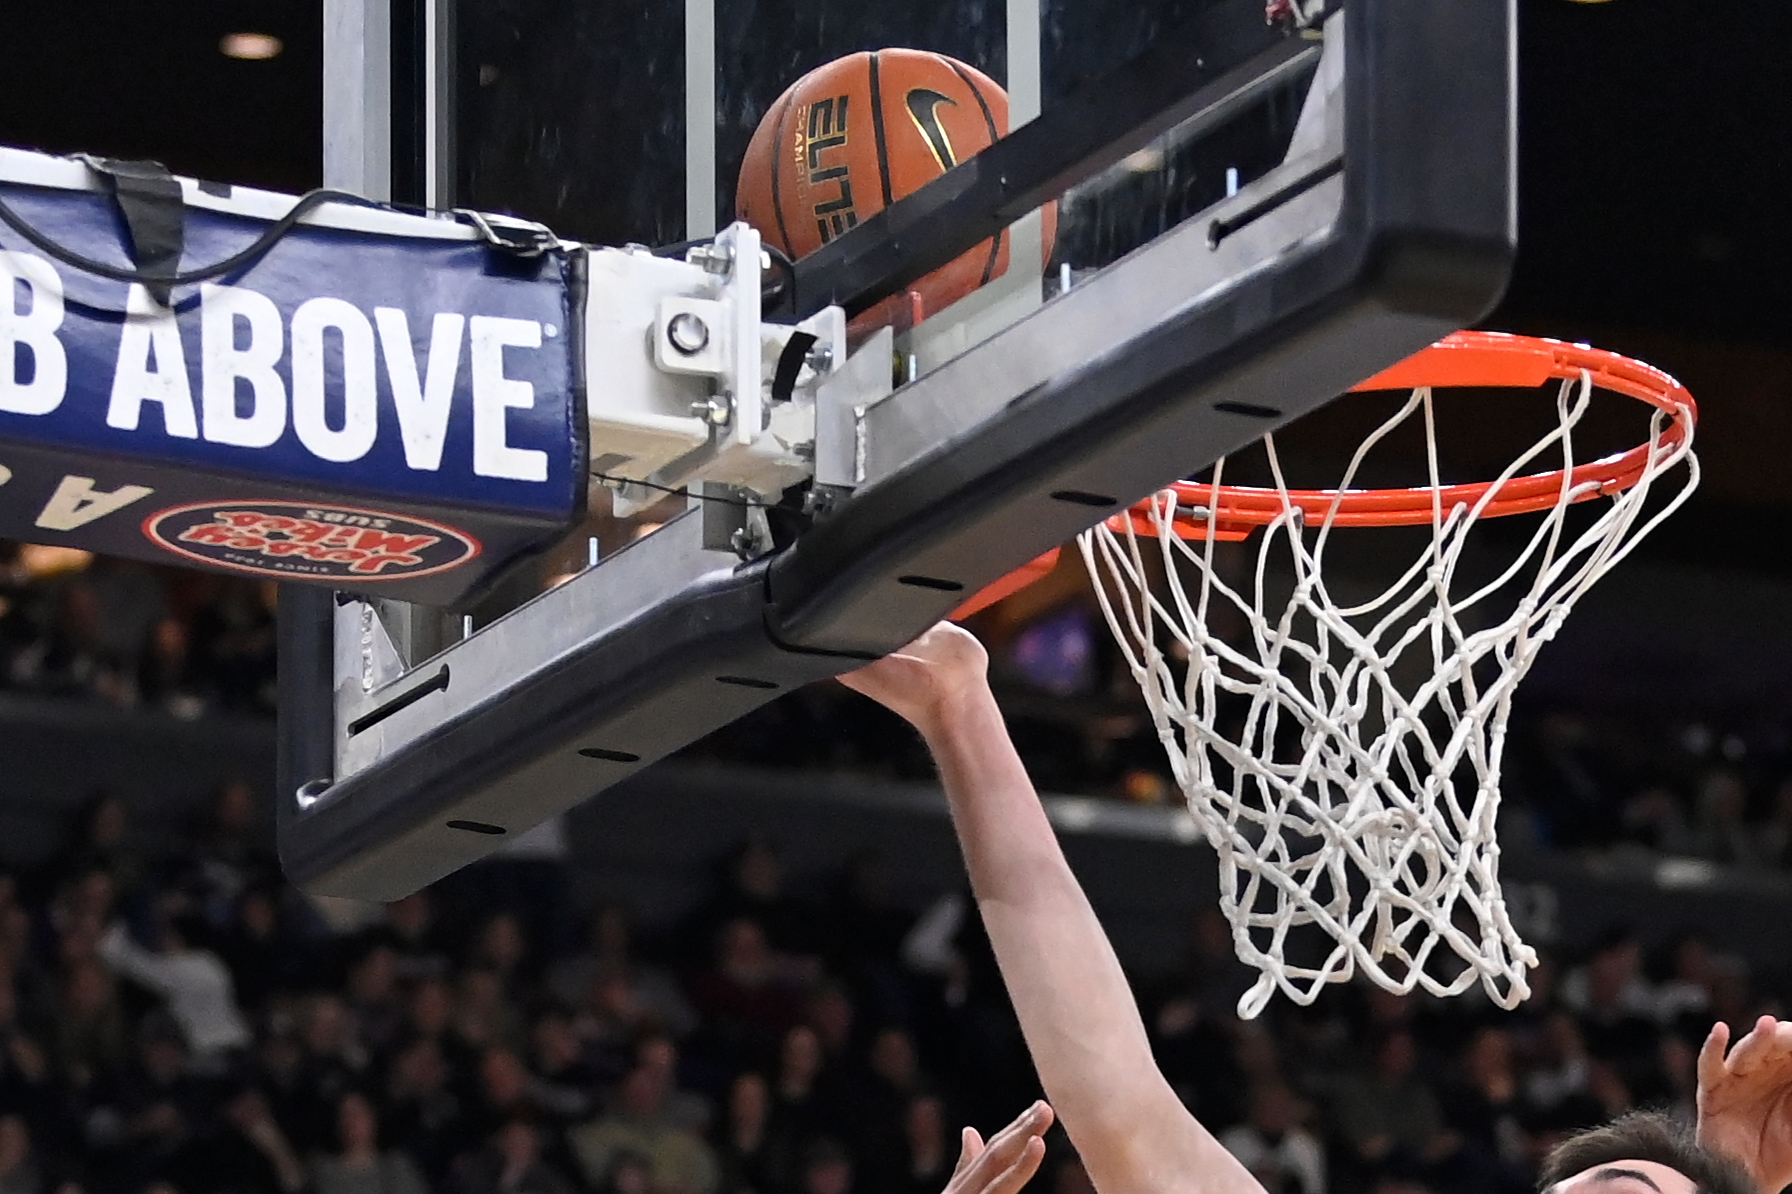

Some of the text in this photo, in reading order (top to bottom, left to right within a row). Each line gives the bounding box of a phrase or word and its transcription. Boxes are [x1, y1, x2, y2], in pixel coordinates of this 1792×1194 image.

[808, 95, 858, 244] ELITE
[106, 283, 548, 481] ABOVE
[303, 509, 391, 528] SUBS
